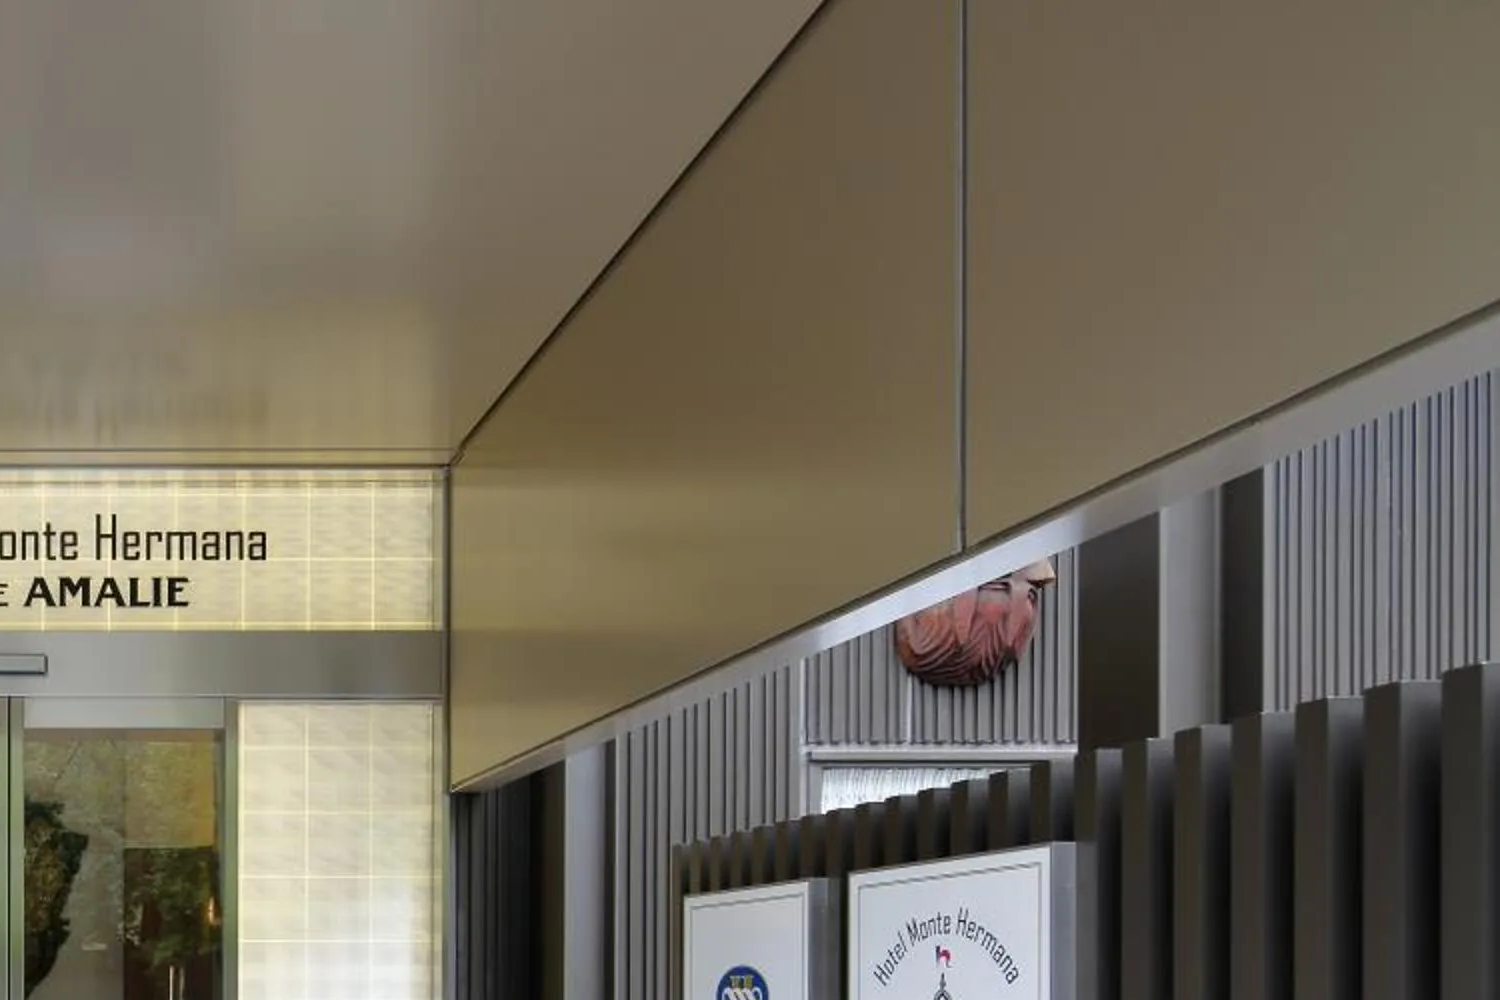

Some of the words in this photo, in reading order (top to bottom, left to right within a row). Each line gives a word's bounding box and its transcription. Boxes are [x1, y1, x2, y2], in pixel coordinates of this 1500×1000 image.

[95, 513, 267, 561] Hermana
[23, 576, 190, 608] AMALIE
[873, 930, 908, 986] Hotel
[906, 912, 951, 946] Monte
[955, 907, 1019, 984] Hermana
